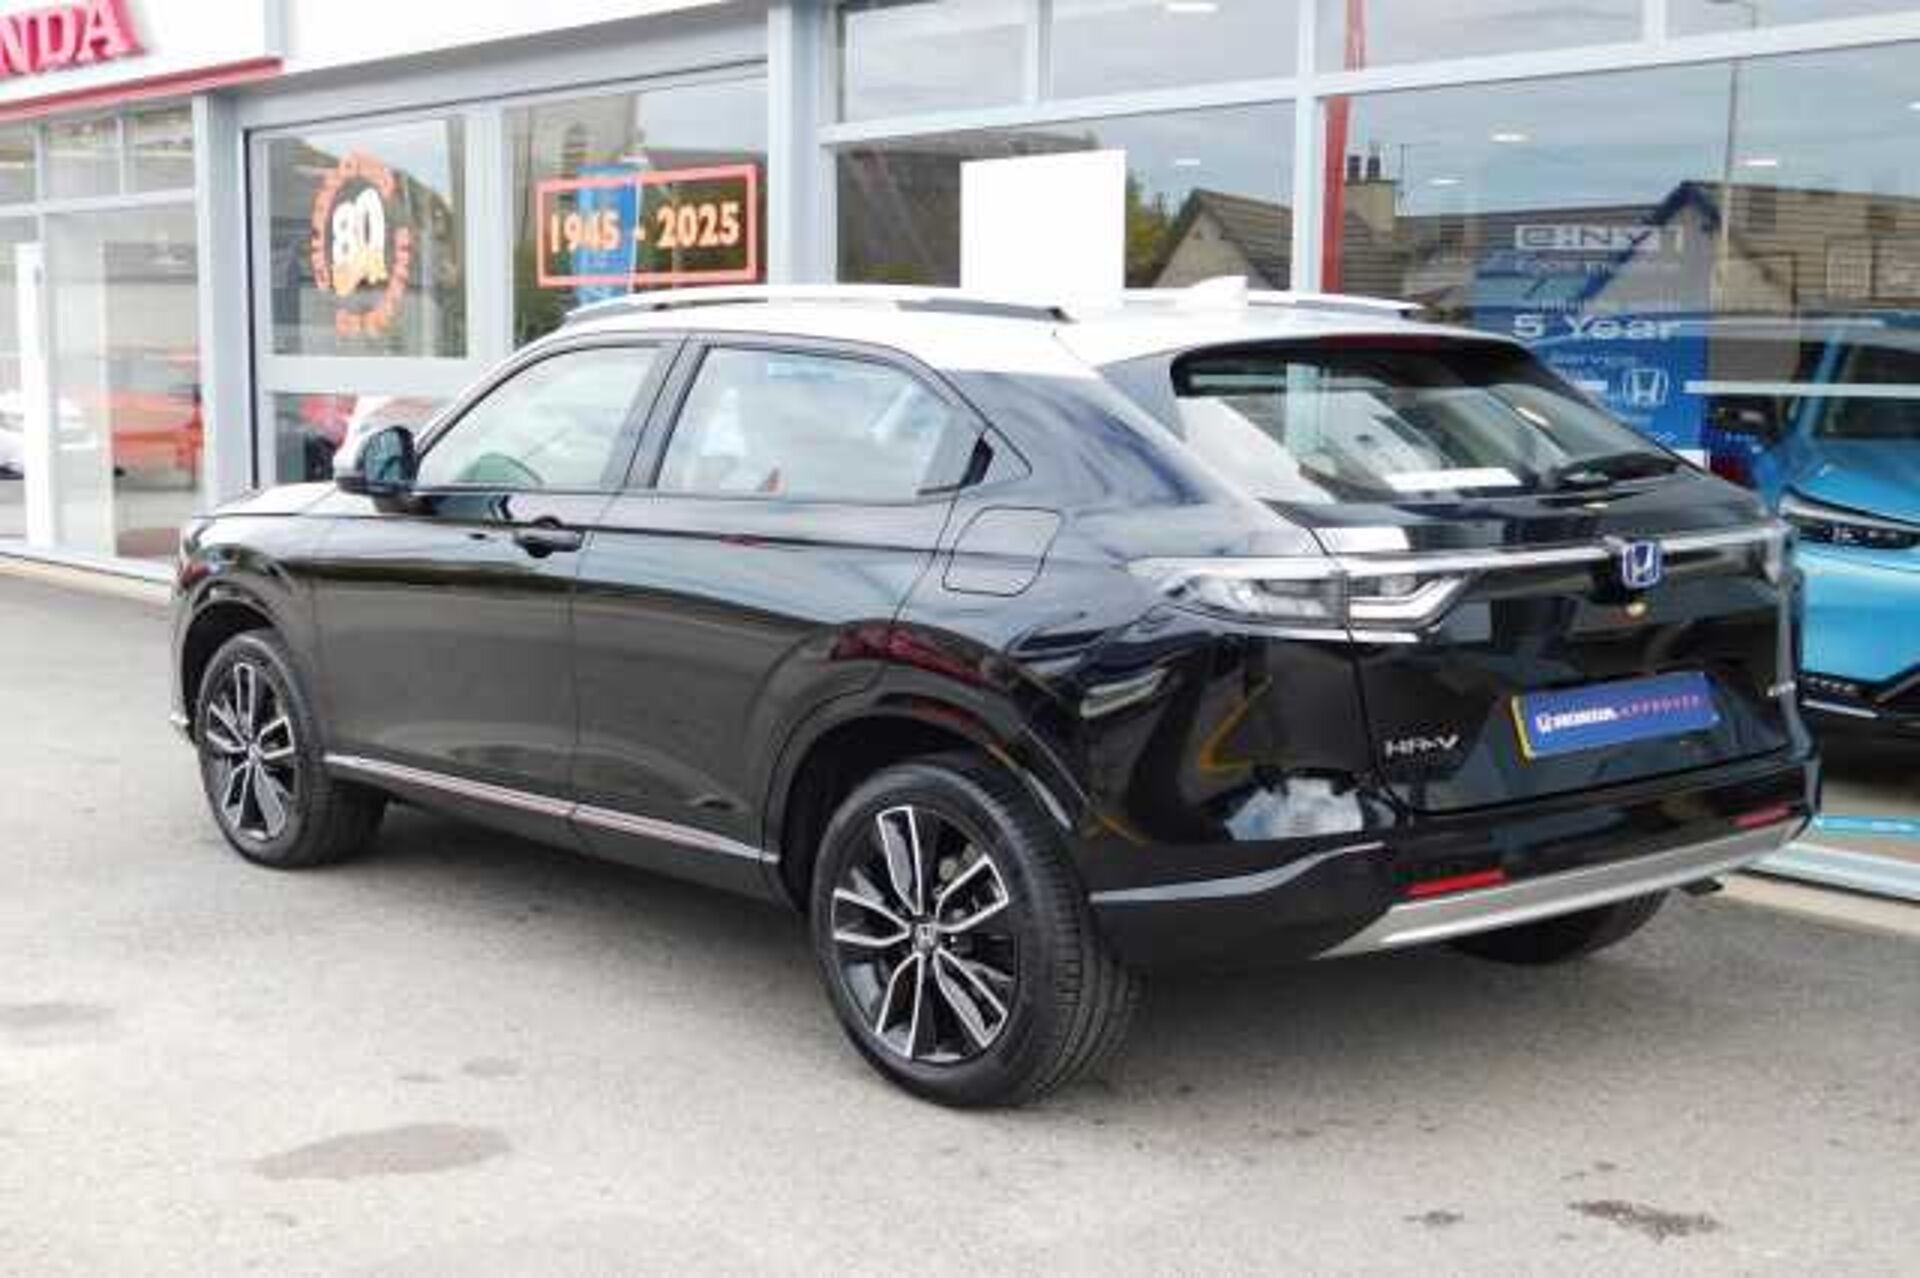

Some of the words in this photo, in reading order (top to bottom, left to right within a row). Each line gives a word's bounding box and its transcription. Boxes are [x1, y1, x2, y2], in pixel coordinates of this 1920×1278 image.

[550, 209, 621, 253] 1945
[655, 201, 740, 249] 2025
[1513, 313, 1545, 339] 5
[1562, 312, 1679, 340] Year
[1385, 734, 1459, 757] HR-V
